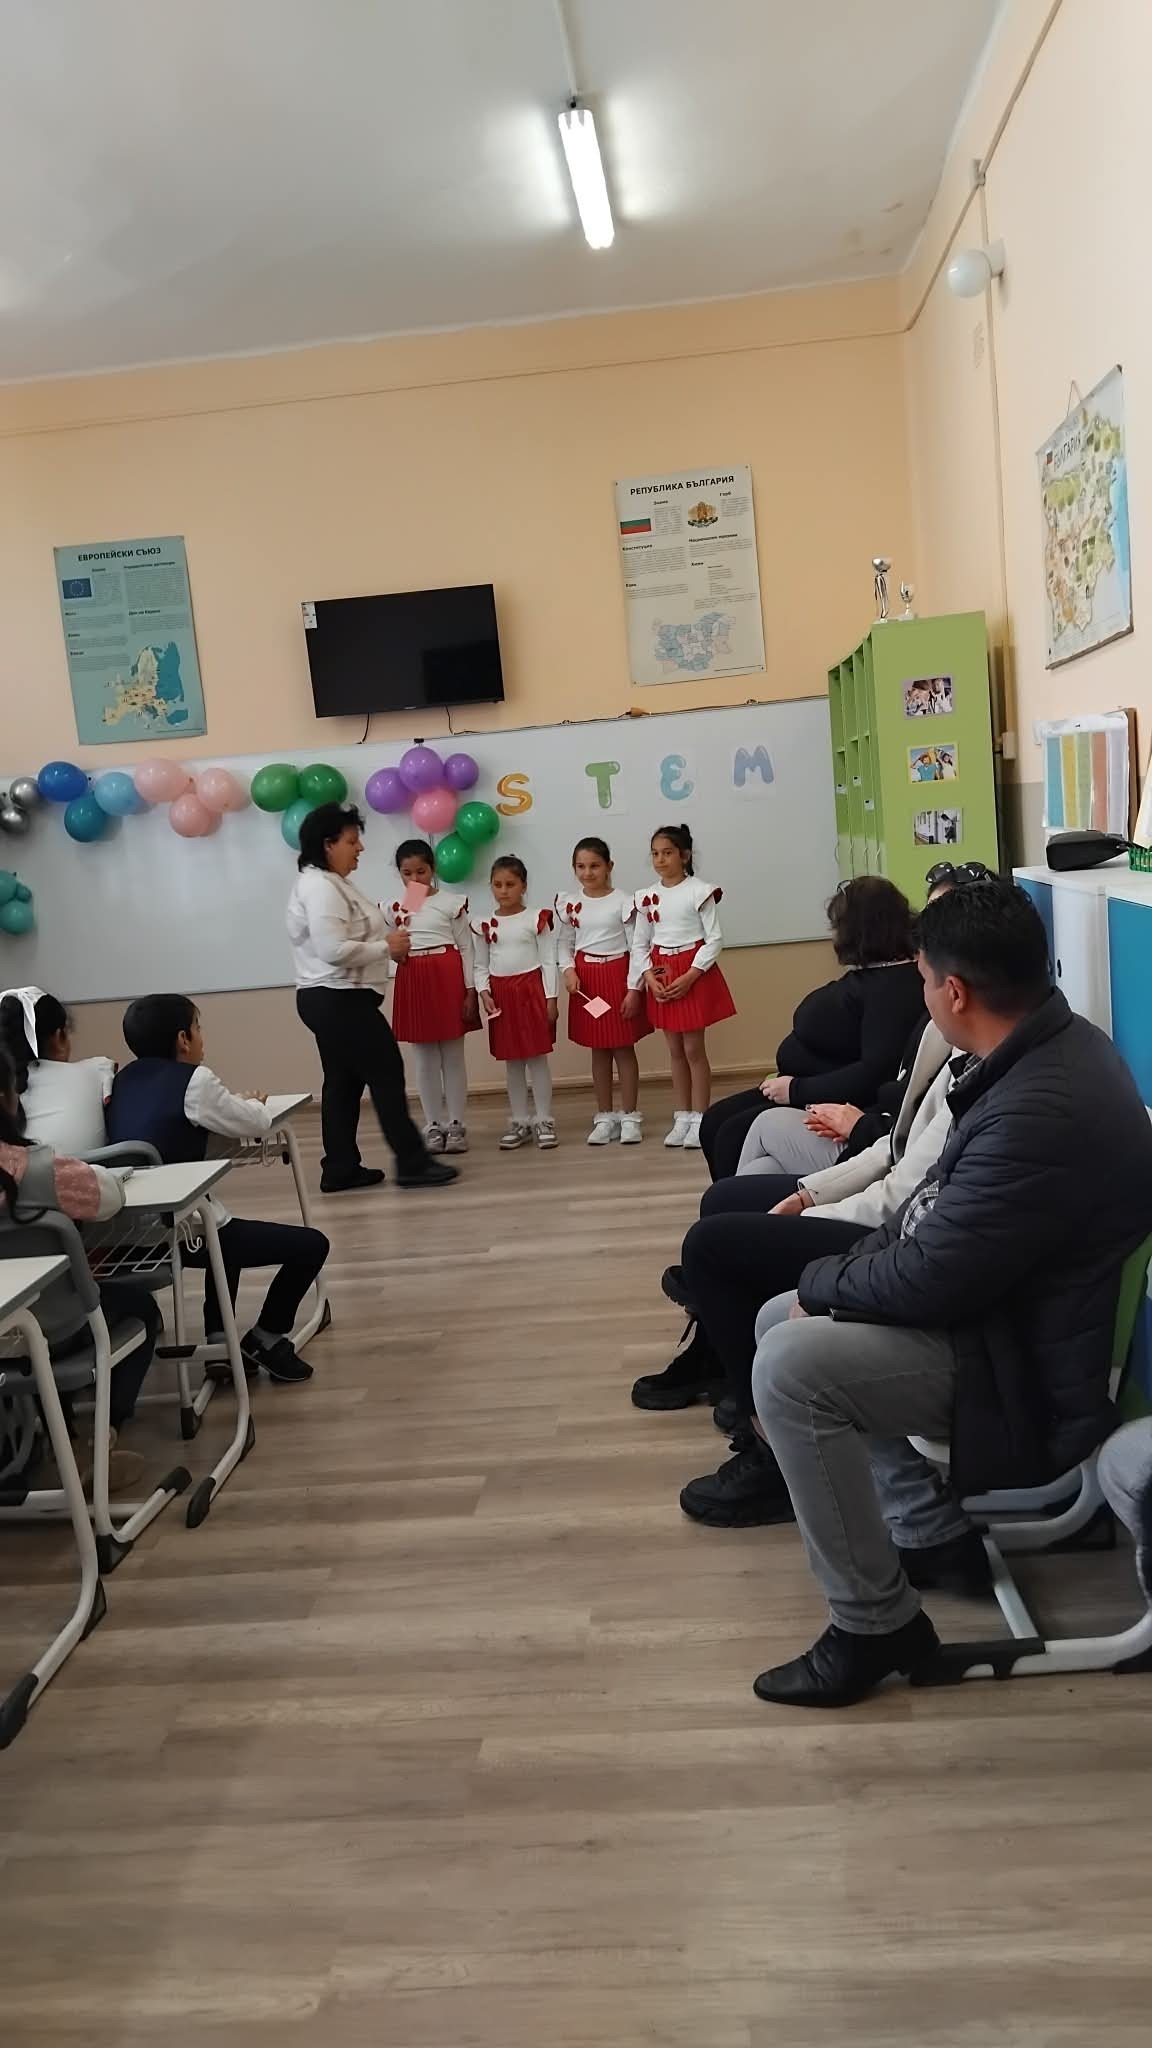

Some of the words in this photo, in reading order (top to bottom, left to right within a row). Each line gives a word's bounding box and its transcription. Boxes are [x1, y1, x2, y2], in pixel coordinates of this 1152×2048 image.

[630, 482, 684, 496] РЕПУБЛИКА
[686, 475, 735, 489] БЪЛГАРИЯ
[78, 549, 134, 562] ЕВРОПЕЙСКИ
[136, 547, 161, 557] СЪЮЗ
